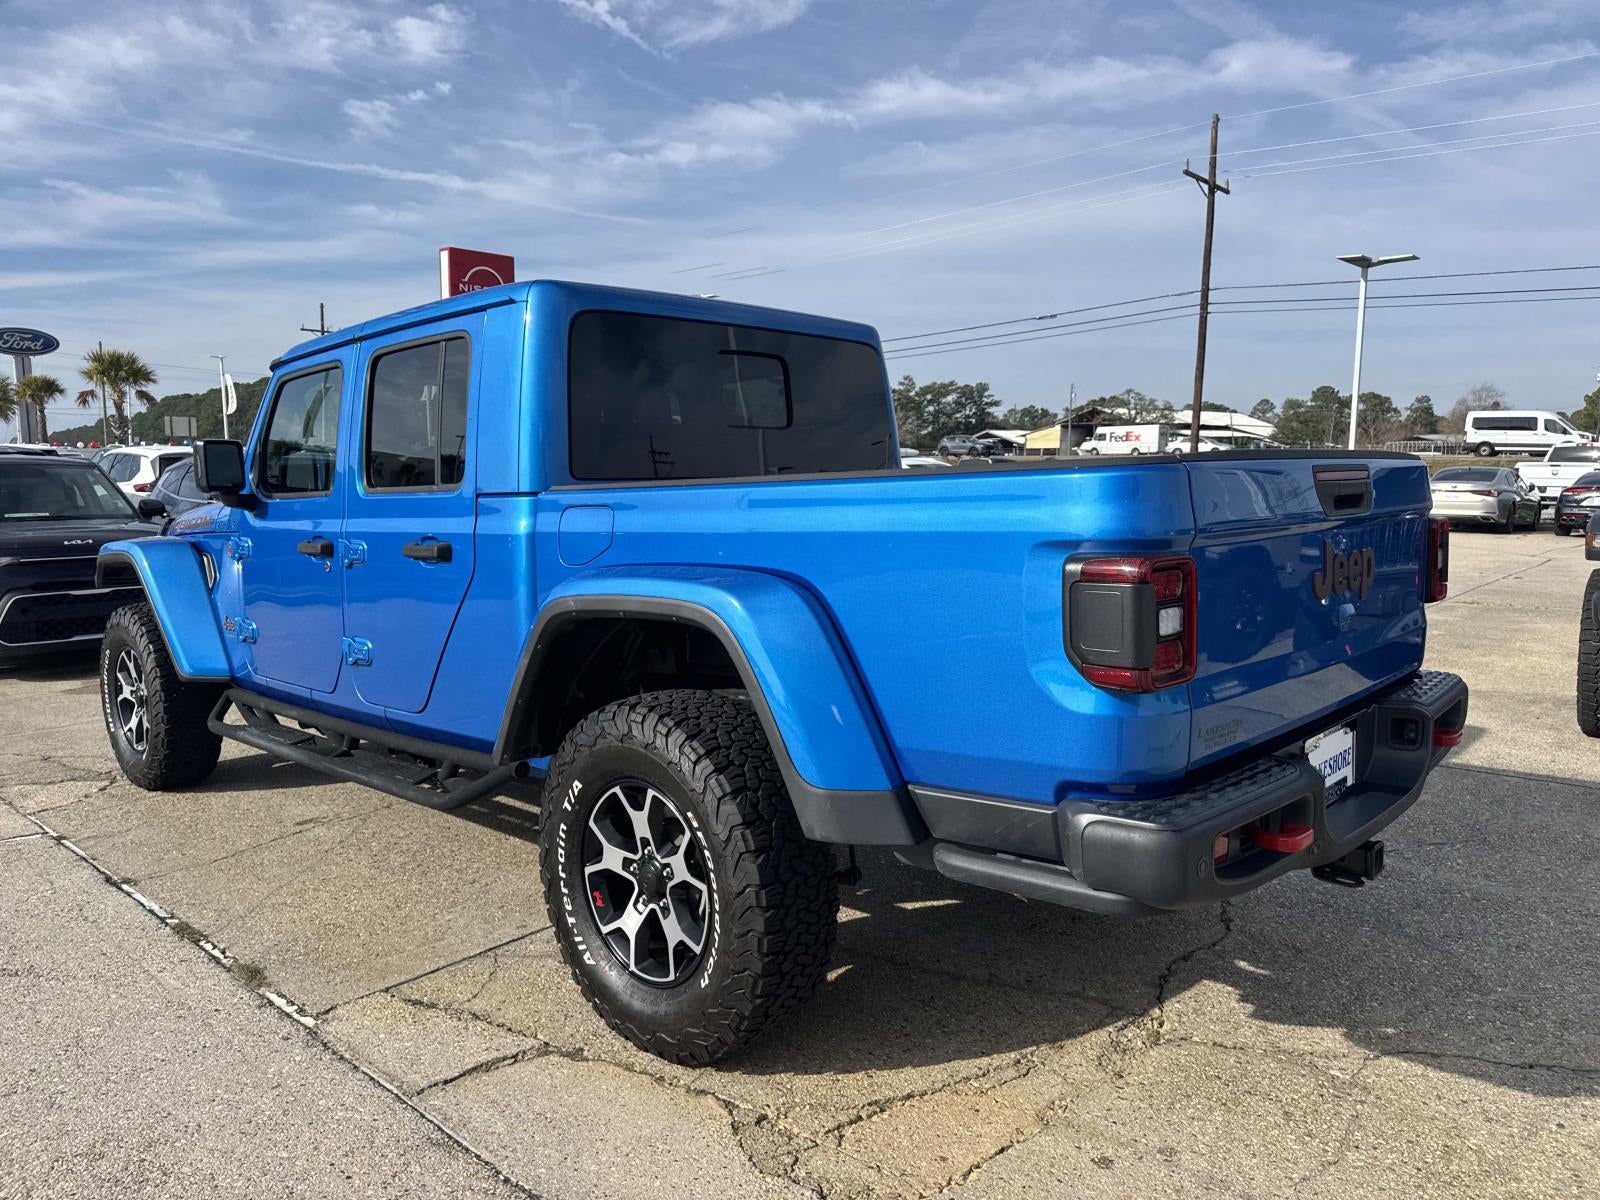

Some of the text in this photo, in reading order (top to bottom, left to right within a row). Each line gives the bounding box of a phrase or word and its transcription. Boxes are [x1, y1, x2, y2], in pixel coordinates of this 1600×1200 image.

[0, 332, 44, 350] Ford
[1109, 431, 1142, 442] FedEx
[1312, 538, 1376, 601] Jeep
[1317, 746, 1352, 779] KESHORE
[557, 779, 597, 966] All-Terrain T/A
[686, 811, 721, 989] BFGoodrich
